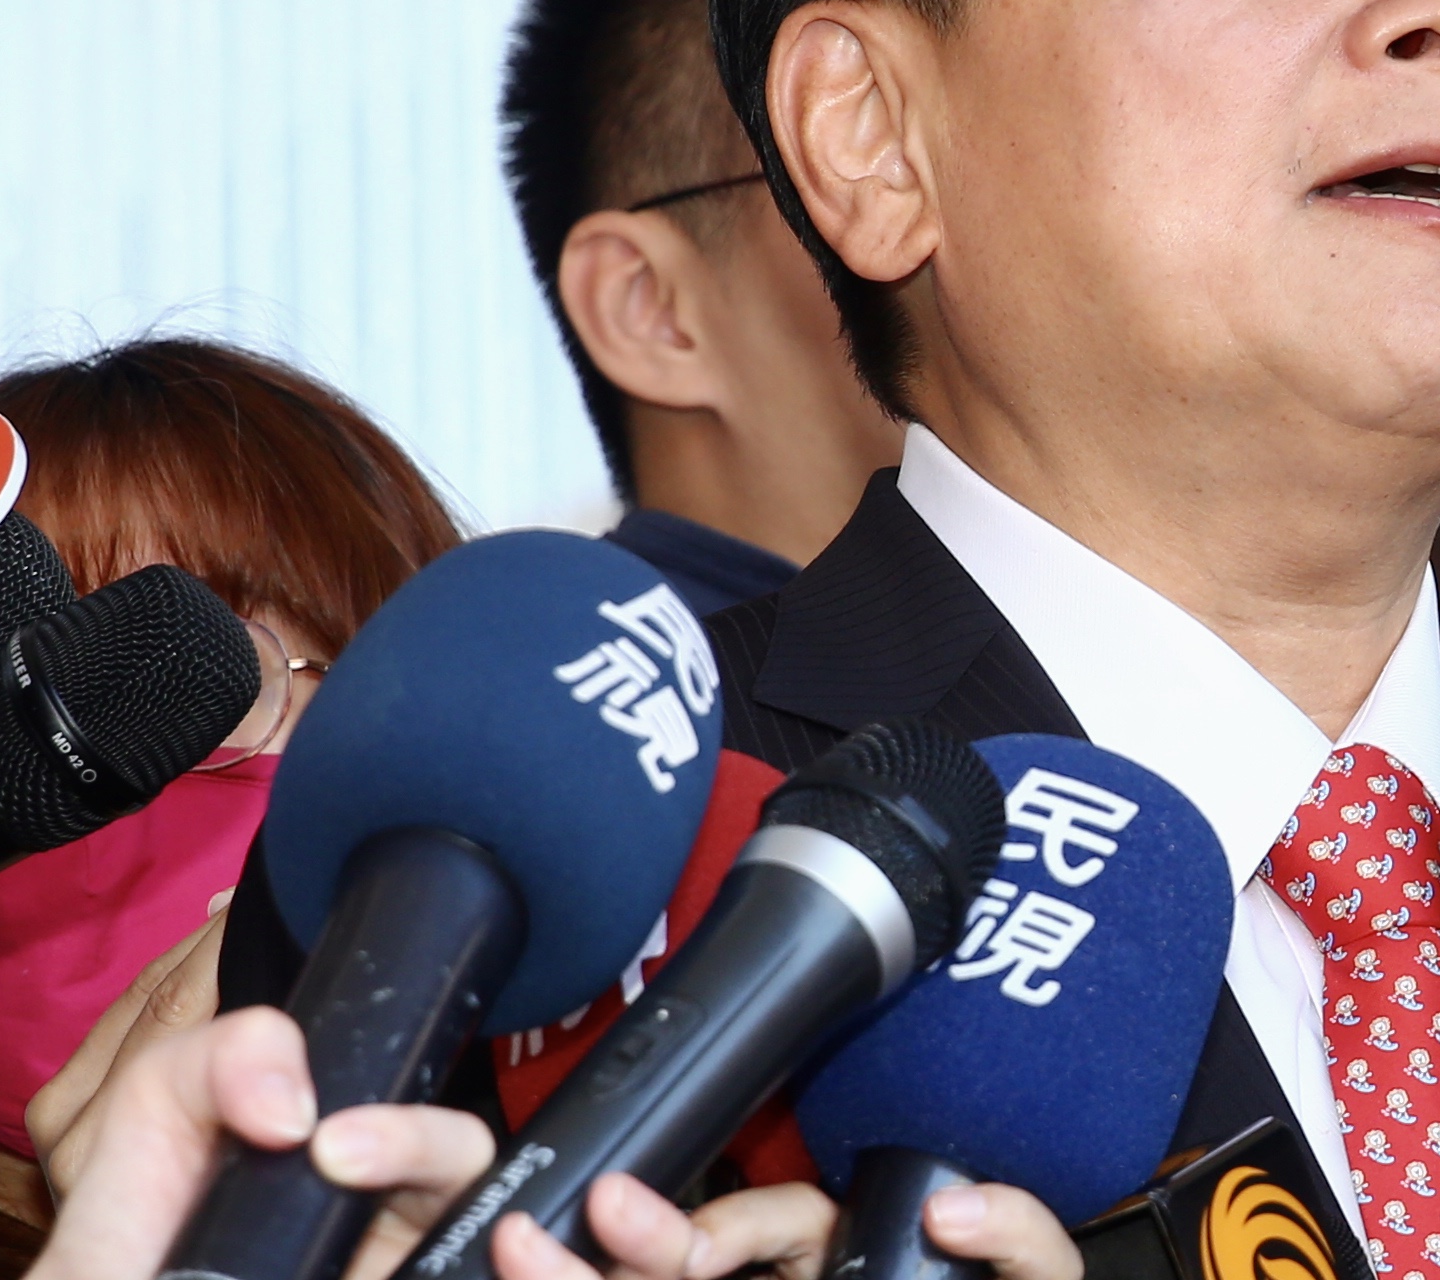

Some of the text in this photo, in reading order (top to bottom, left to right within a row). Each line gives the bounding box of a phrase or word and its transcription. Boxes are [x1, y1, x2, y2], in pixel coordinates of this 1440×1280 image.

[51, 731, 85, 769] MD 42
[554, 582, 721, 794] 民視
[946, 767, 1140, 1007] 民視
